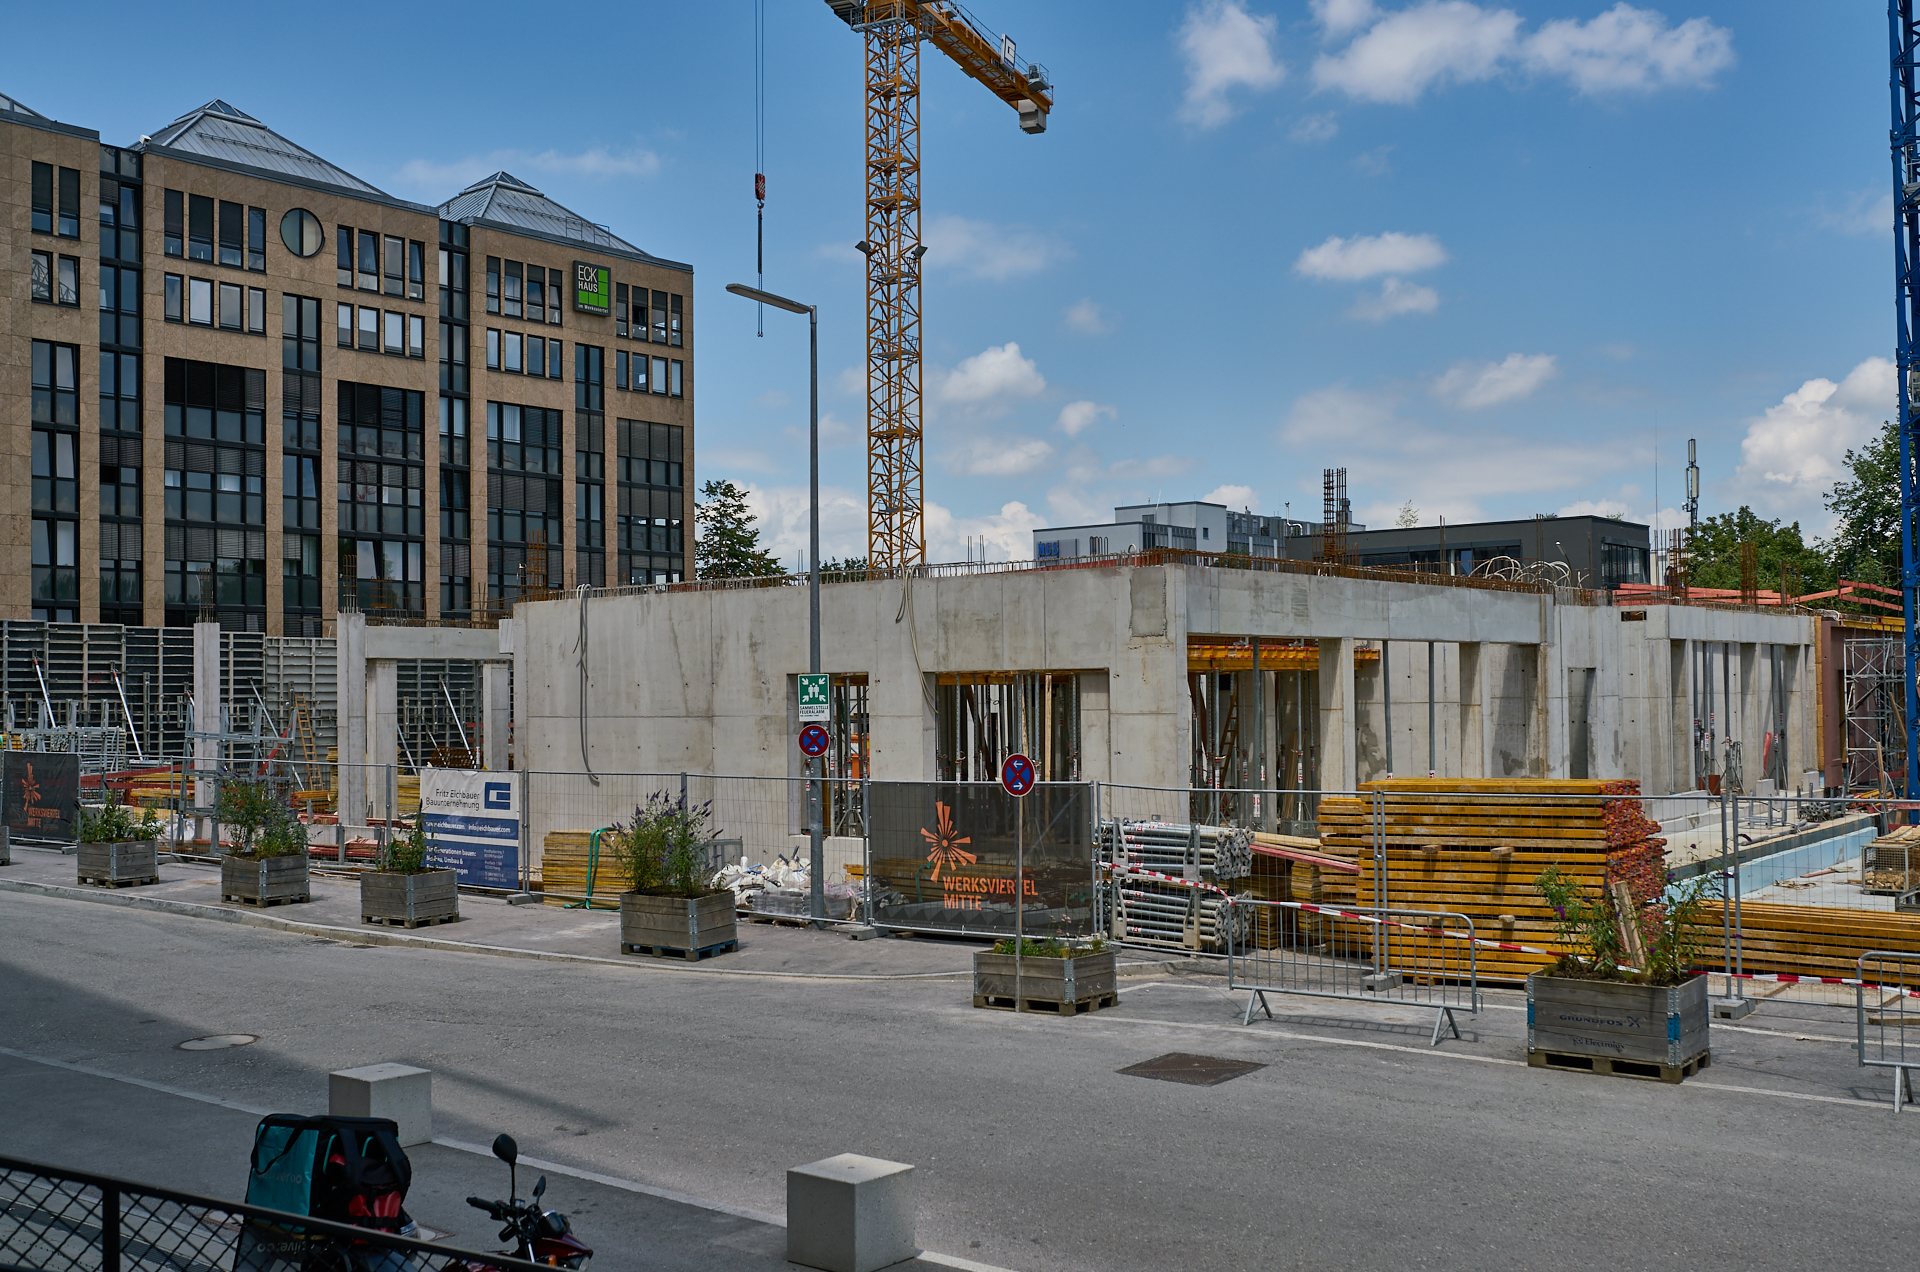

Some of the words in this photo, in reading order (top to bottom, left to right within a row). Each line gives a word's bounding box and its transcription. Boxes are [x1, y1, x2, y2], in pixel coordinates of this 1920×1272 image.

[578, 264, 598, 283] ECK
[578, 281, 598, 293] HAUS
[435, 788, 449, 798] Fritz
[450, 789, 480, 800] Eichbauer
[425, 796, 480, 812] Bauunternehmung
[28, 807, 60, 819] WERKSVIERTEL
[27, 817, 41, 828] MITTE
[942, 875, 1039, 896] WERKSVIEREL
[943, 893, 982, 911] MITTE
[1559, 1014, 1624, 1027] GRUNDFOS
[1585, 1038, 1626, 1050] Electrolux
